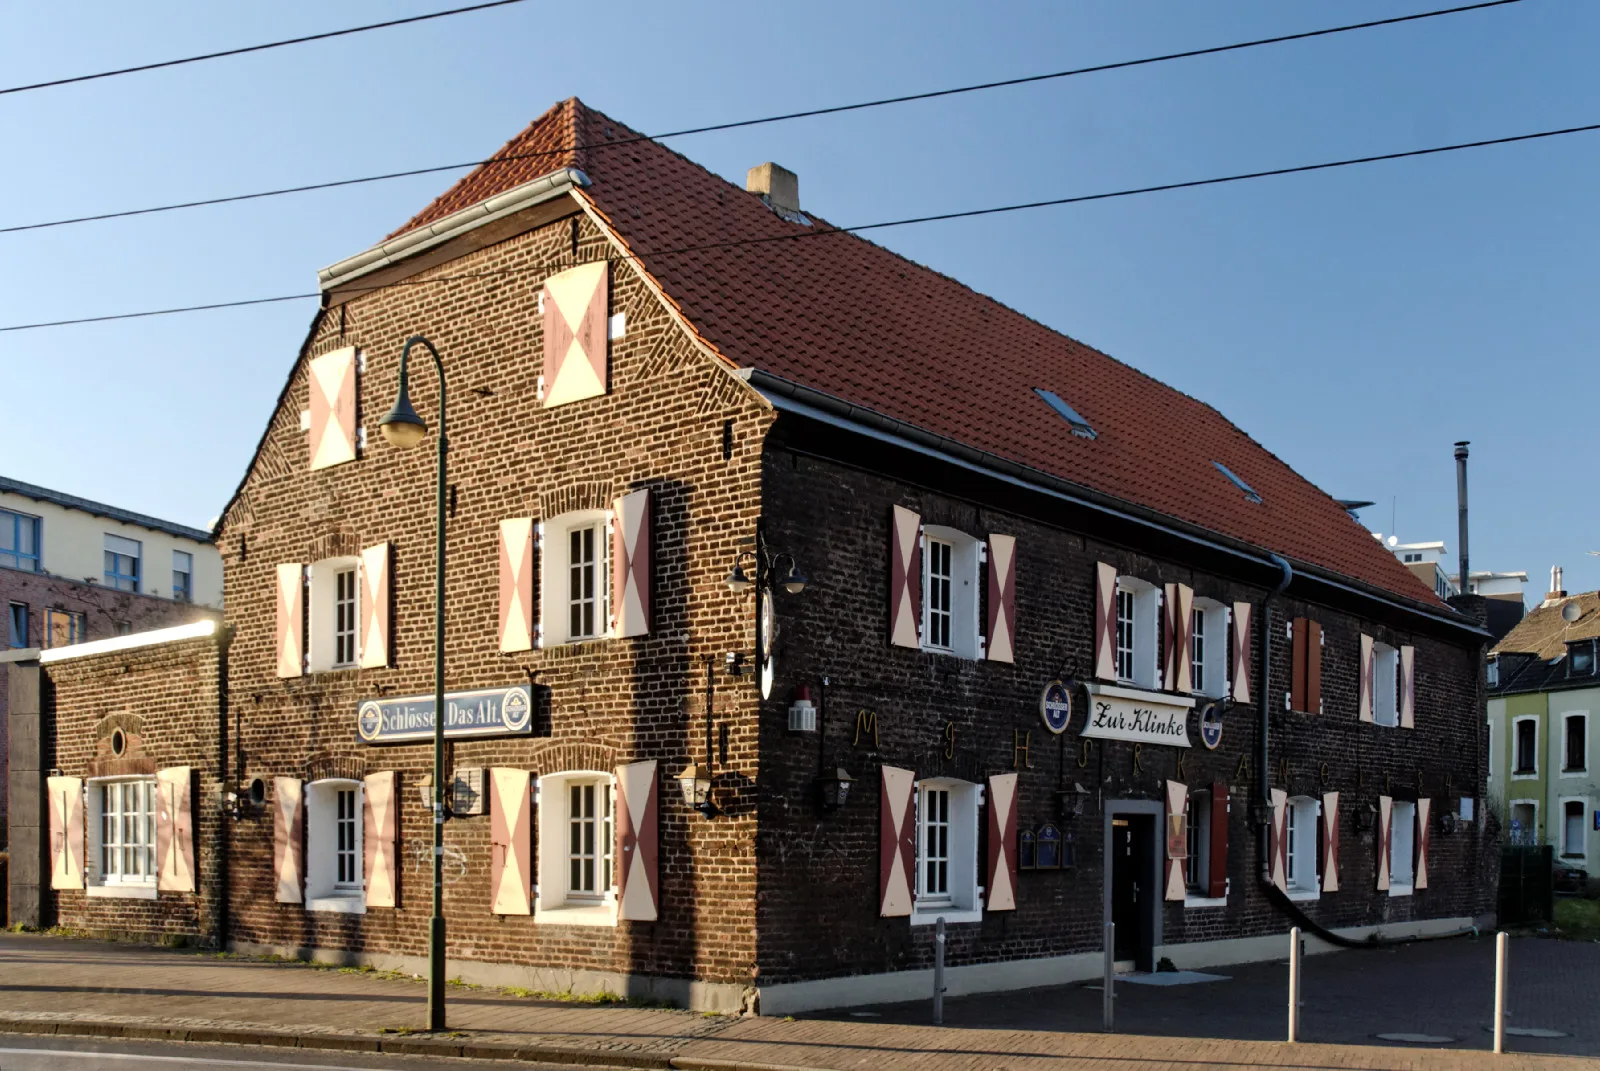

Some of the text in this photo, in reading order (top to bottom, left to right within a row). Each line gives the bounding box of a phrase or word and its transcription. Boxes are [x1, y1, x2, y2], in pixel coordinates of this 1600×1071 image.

[382, 699, 502, 732] Schlösse. Das Alt.
[1092, 702, 1184, 736] Zur Klinke
